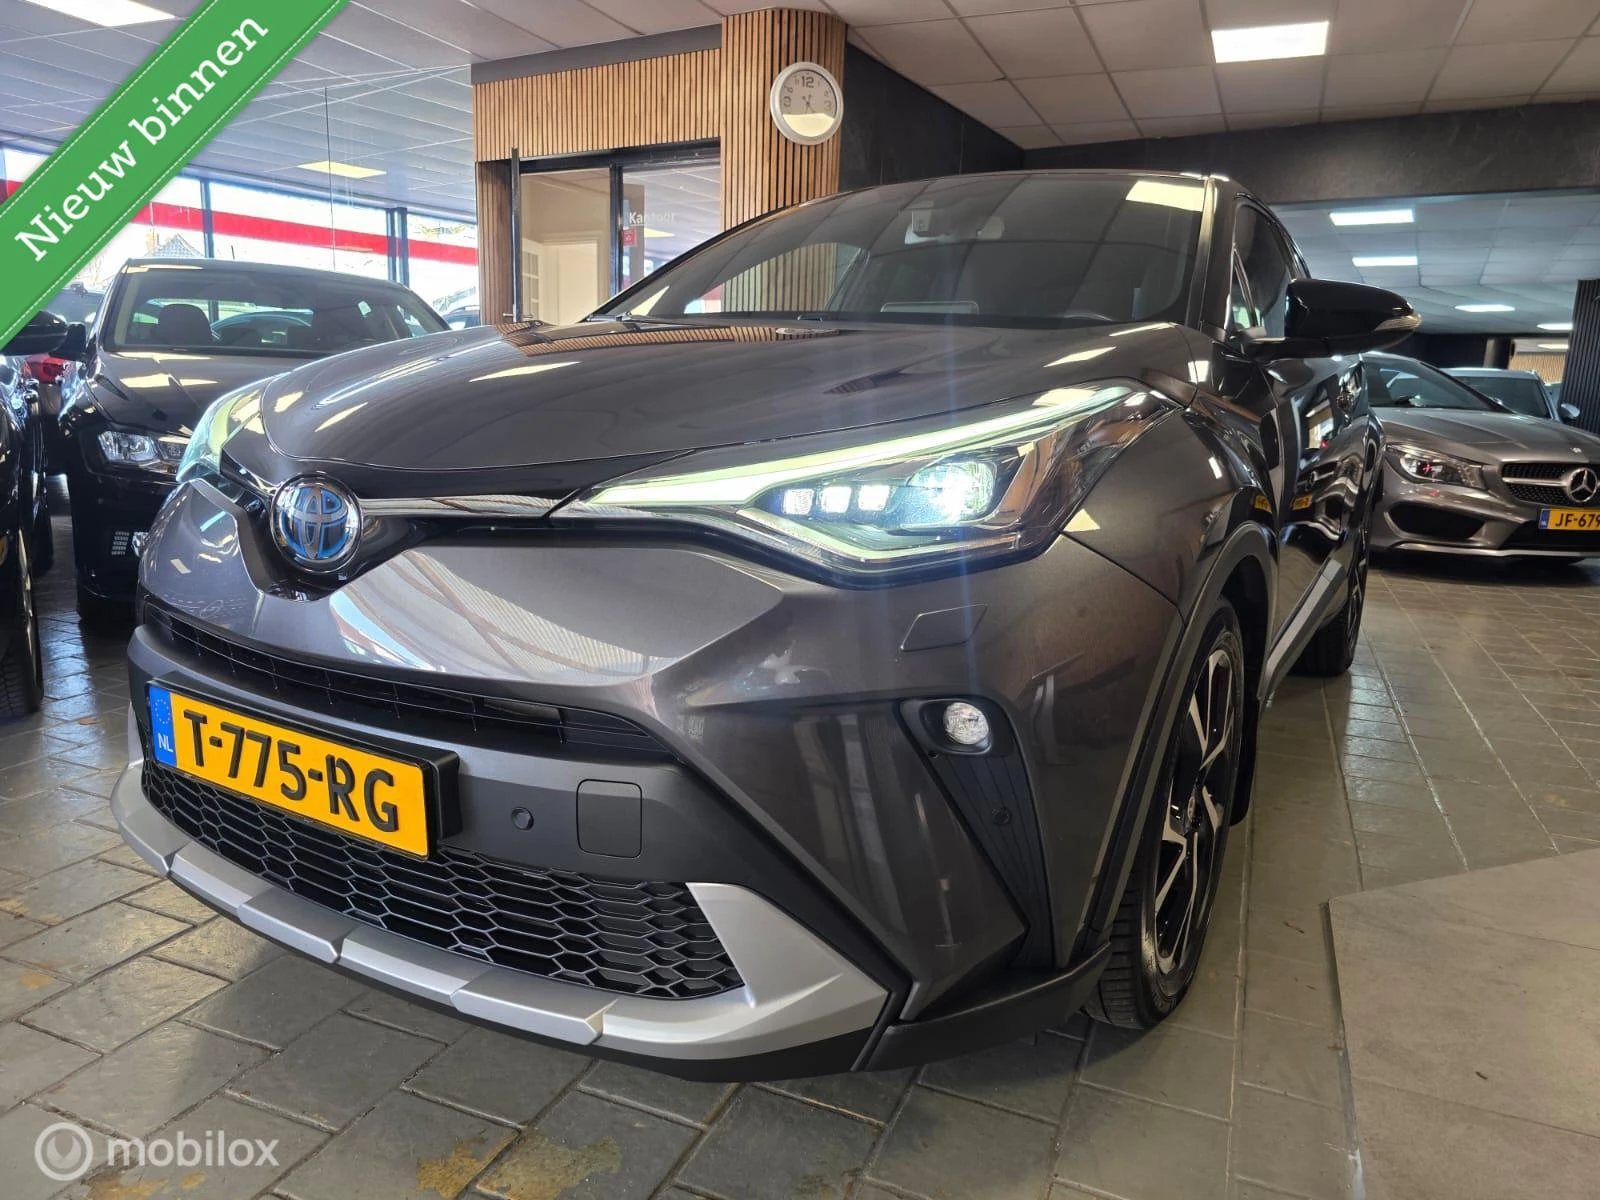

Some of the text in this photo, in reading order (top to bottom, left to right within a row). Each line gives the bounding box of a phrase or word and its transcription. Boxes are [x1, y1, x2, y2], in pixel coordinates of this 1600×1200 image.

[801, 76, 814, 88] 12
[158, 731, 174, 753] NL
[183, 709, 399, 832] T-775-RG
